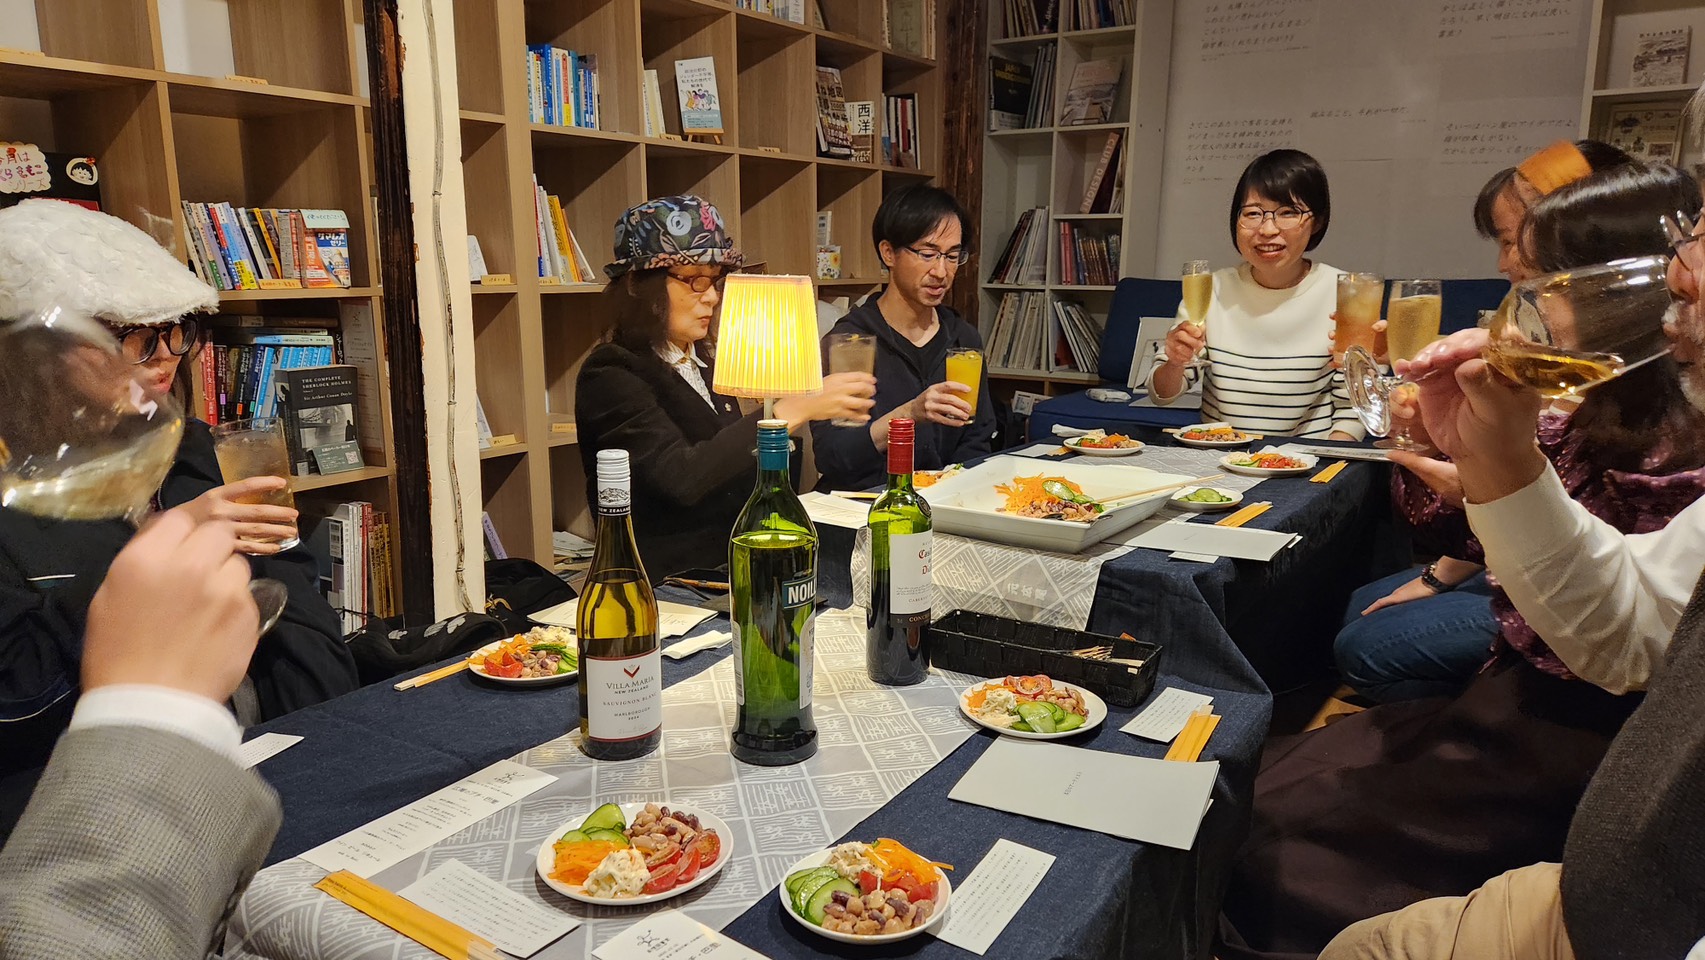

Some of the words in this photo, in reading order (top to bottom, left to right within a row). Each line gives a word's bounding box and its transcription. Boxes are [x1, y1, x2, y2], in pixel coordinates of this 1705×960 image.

[858, 103, 871, 134] 西洋
[1100, 139, 1115, 164] CLUB
[8, 177, 47, 191] シリーズ
[1082, 168, 1104, 208] DESIGN
[606, 682, 630, 690] VILLA
[632, 676, 654, 688] MARIA
[614, 707, 651, 717] MARLBOROUGH
